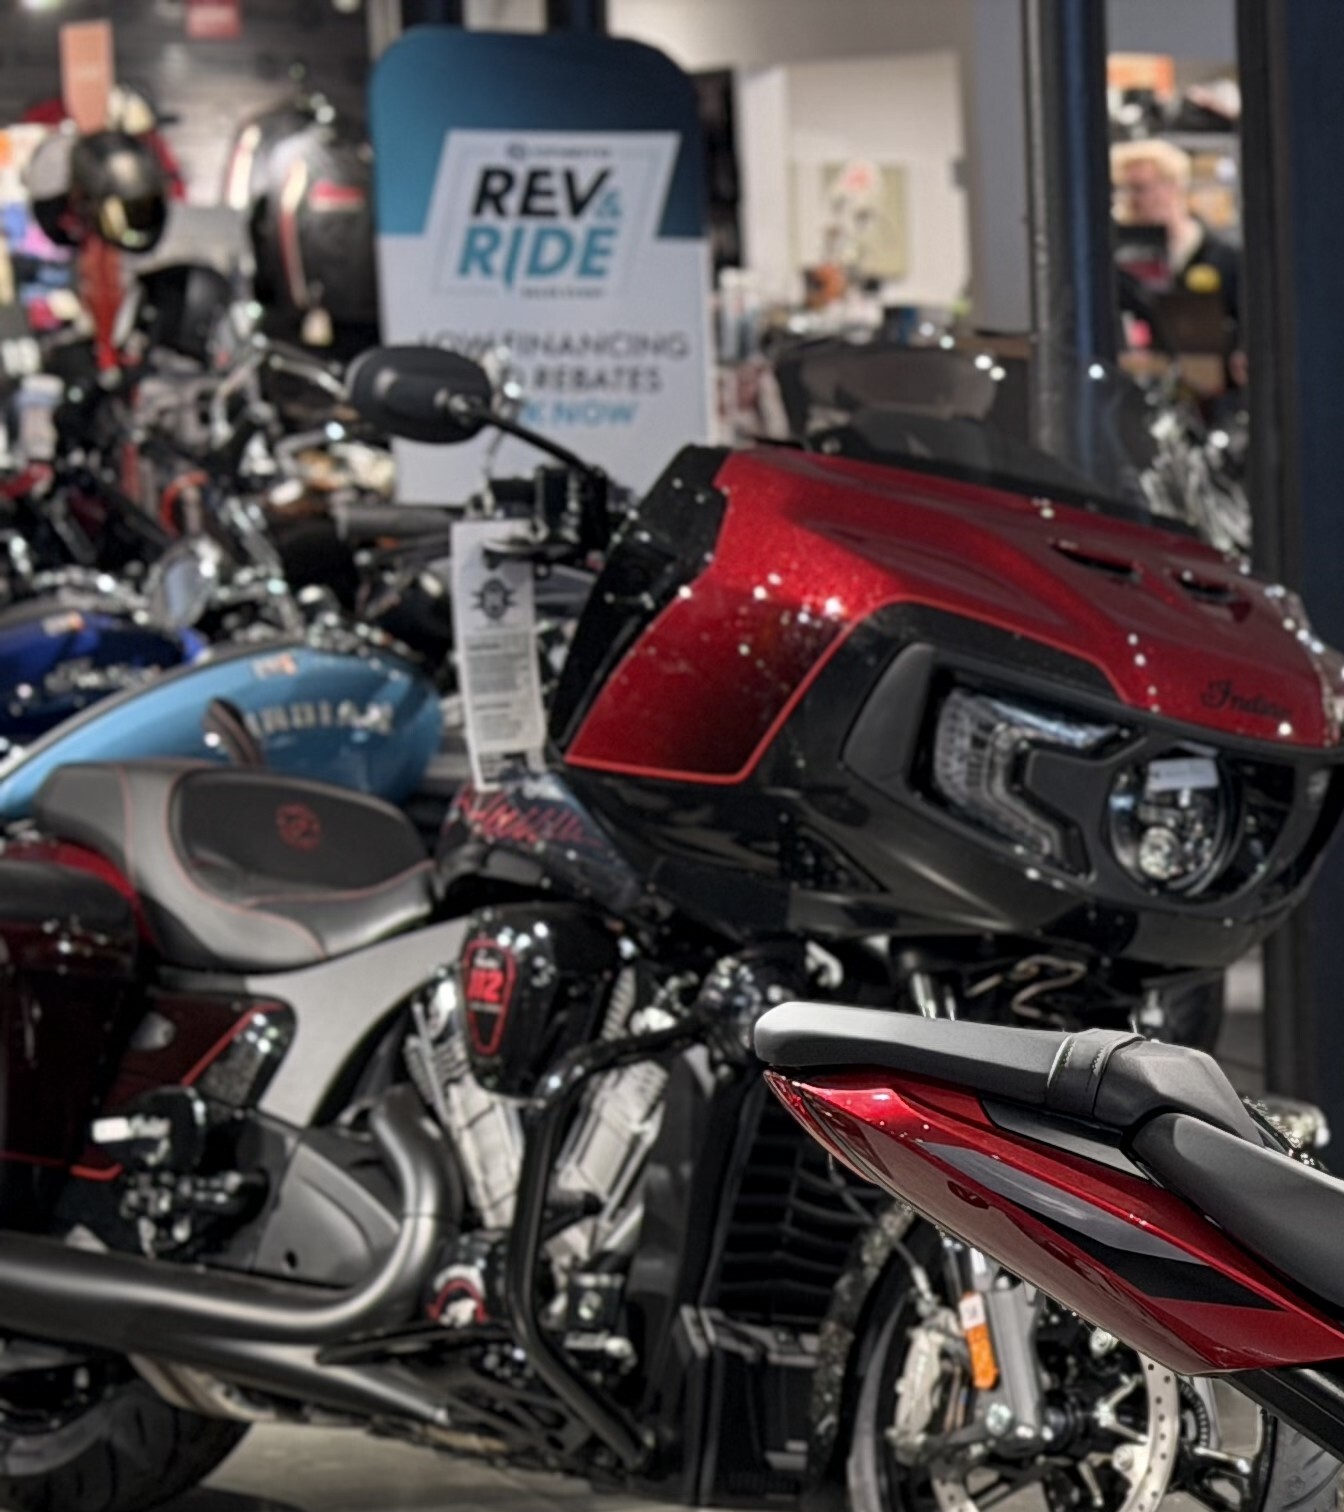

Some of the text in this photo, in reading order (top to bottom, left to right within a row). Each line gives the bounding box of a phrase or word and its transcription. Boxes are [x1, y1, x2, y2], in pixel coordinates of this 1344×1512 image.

[472, 165, 611, 219] REV
[457, 226, 617, 287] RIDE
[533, 364, 664, 393] REBATES
[551, 400, 640, 425] NOW
